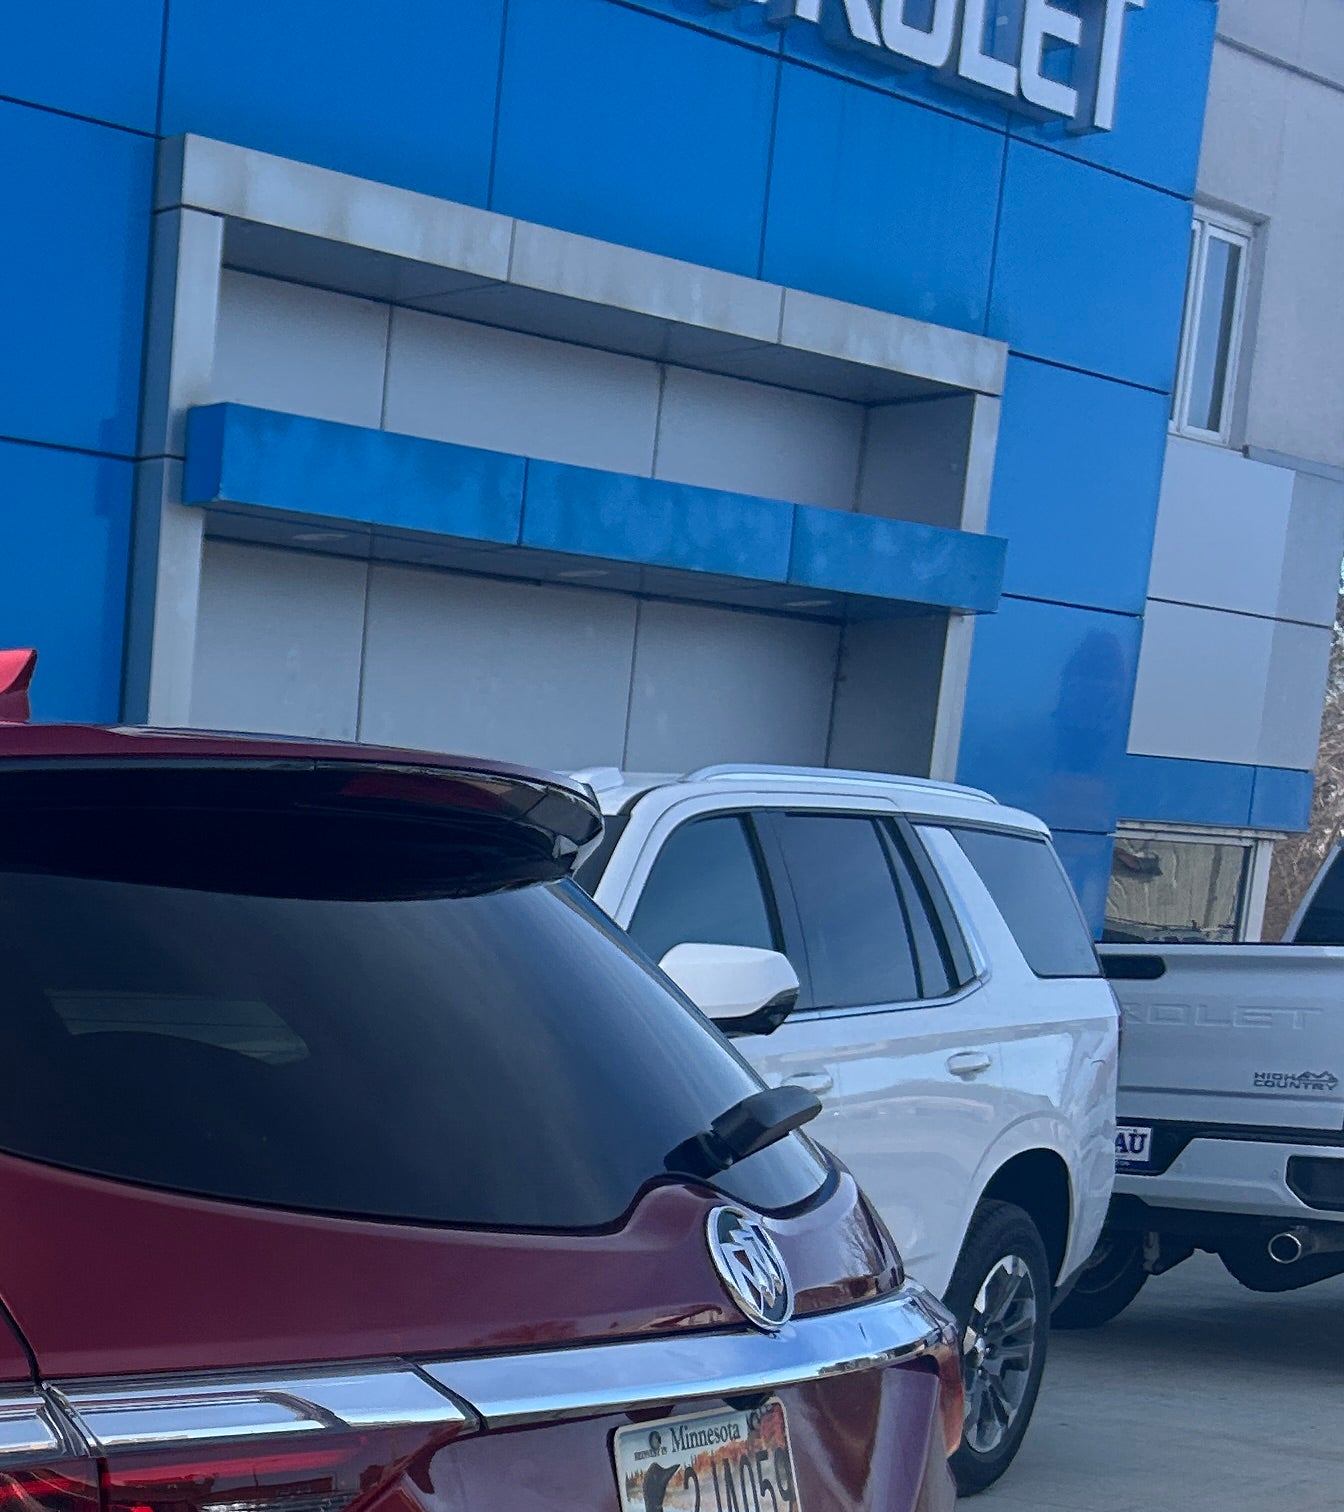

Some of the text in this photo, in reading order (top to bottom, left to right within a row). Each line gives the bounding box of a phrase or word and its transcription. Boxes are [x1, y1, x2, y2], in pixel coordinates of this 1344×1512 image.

[795, 0, 1146, 133] LET
[1254, 1080, 1338, 1091] COUNTRY
[670, 1423, 742, 1453] Minnesota
